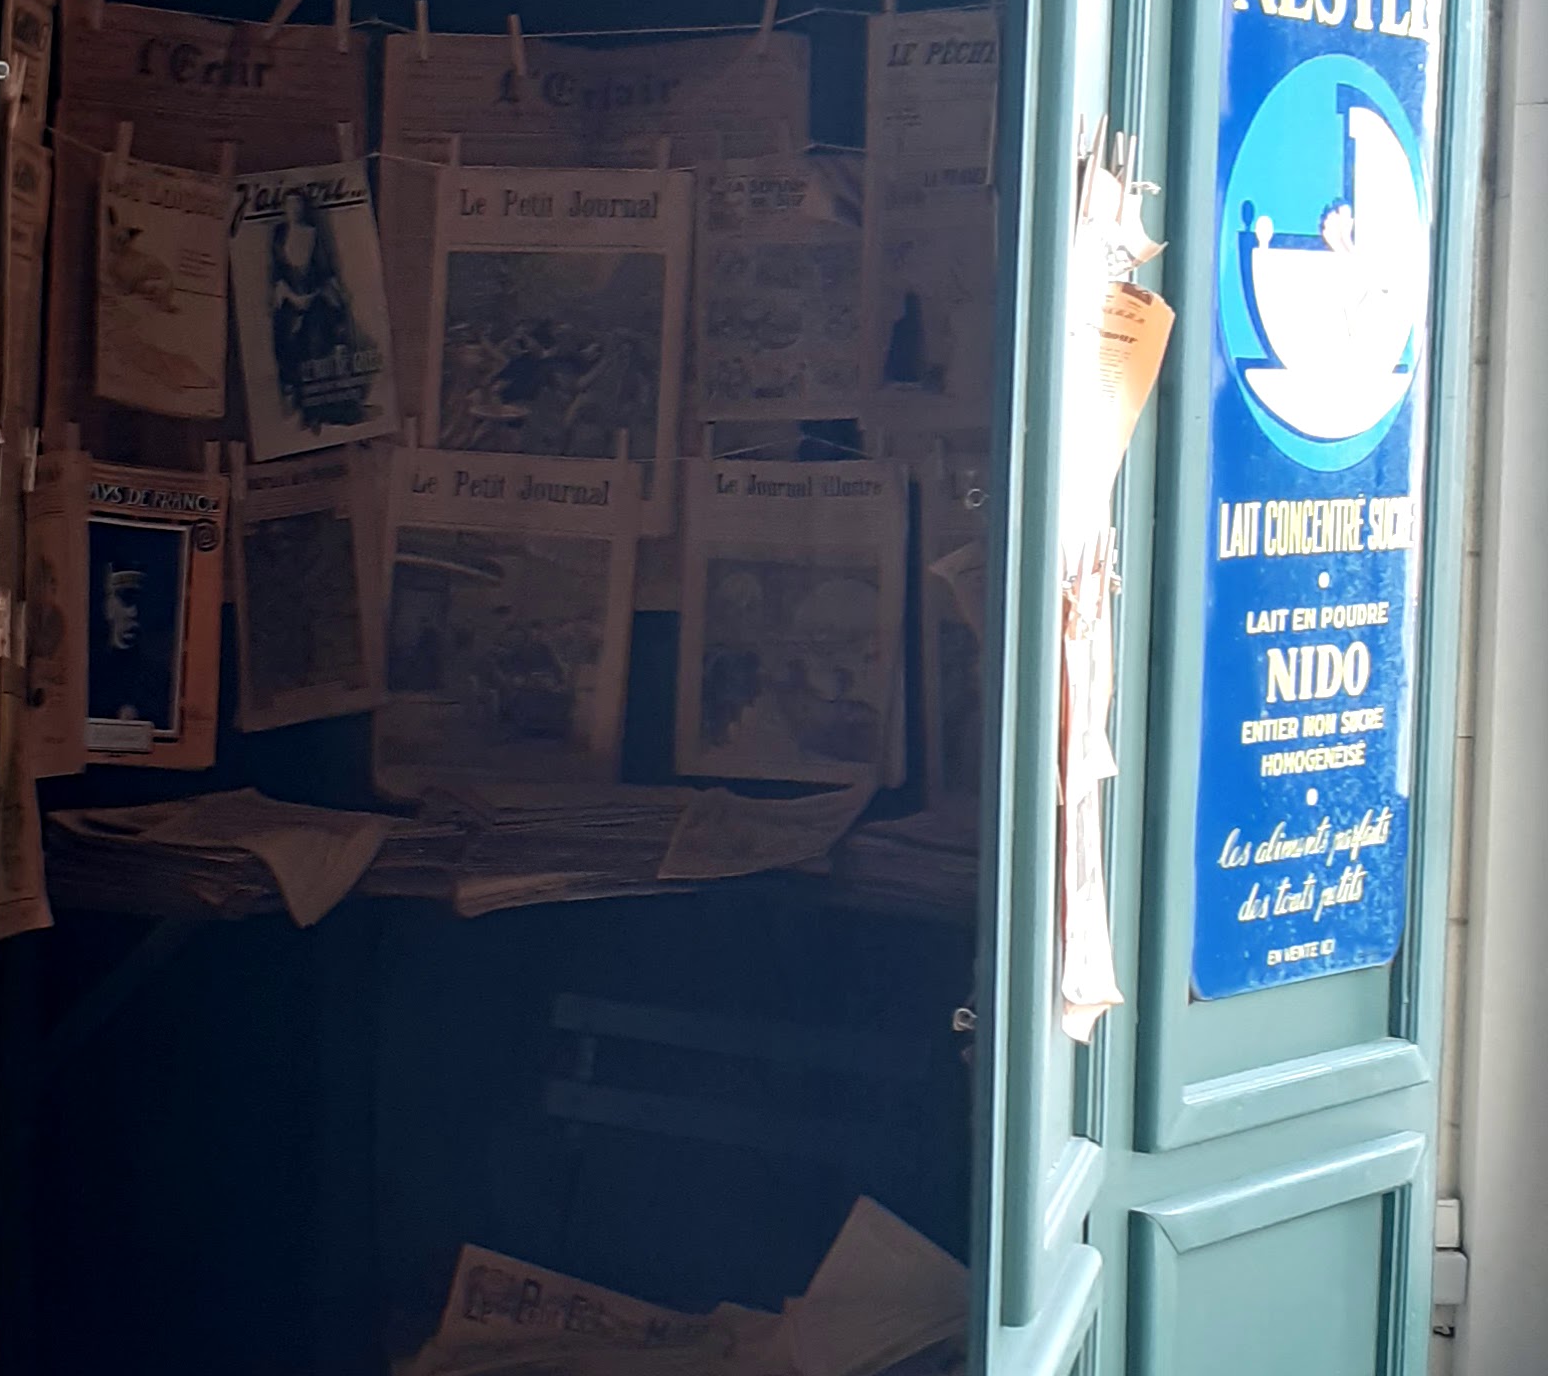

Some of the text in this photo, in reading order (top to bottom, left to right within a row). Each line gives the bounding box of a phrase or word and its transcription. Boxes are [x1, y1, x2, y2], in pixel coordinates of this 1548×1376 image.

[458, 187, 659, 219] Le Petit Journal
[89, 482, 124, 504] AYS
[126, 488, 150, 507] DE
[411, 472, 610, 507] Le Petit Journal
[1218, 502, 1262, 560] LAIT
[1246, 601, 1390, 634] LAIT EN POUDRE
[1265, 640, 1371, 704] NIDO
[1241, 716, 1299, 745] ENTIER
[1302, 713, 1338, 738] NON
